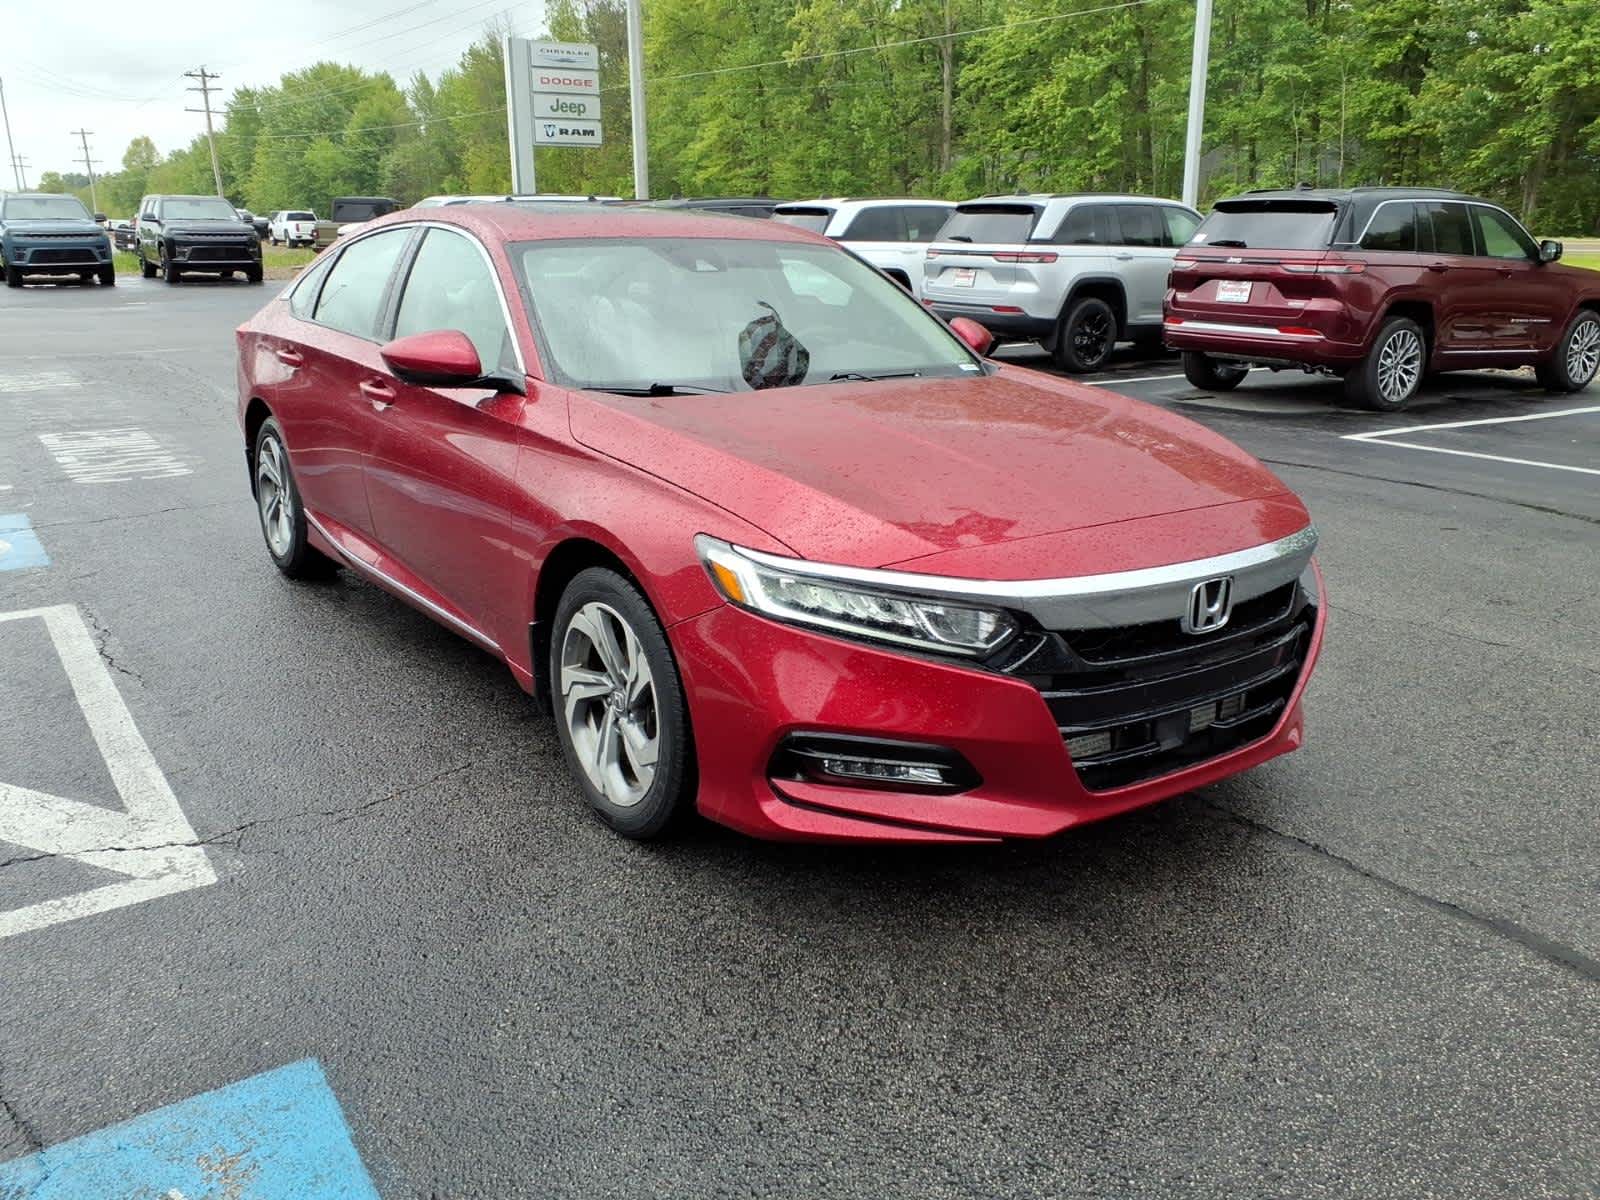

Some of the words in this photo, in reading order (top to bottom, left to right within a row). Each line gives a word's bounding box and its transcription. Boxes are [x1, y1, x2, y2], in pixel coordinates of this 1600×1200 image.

[540, 77, 593, 87] DODGE
[550, 98, 586, 116] Jeep
[559, 128, 595, 137] RAM
